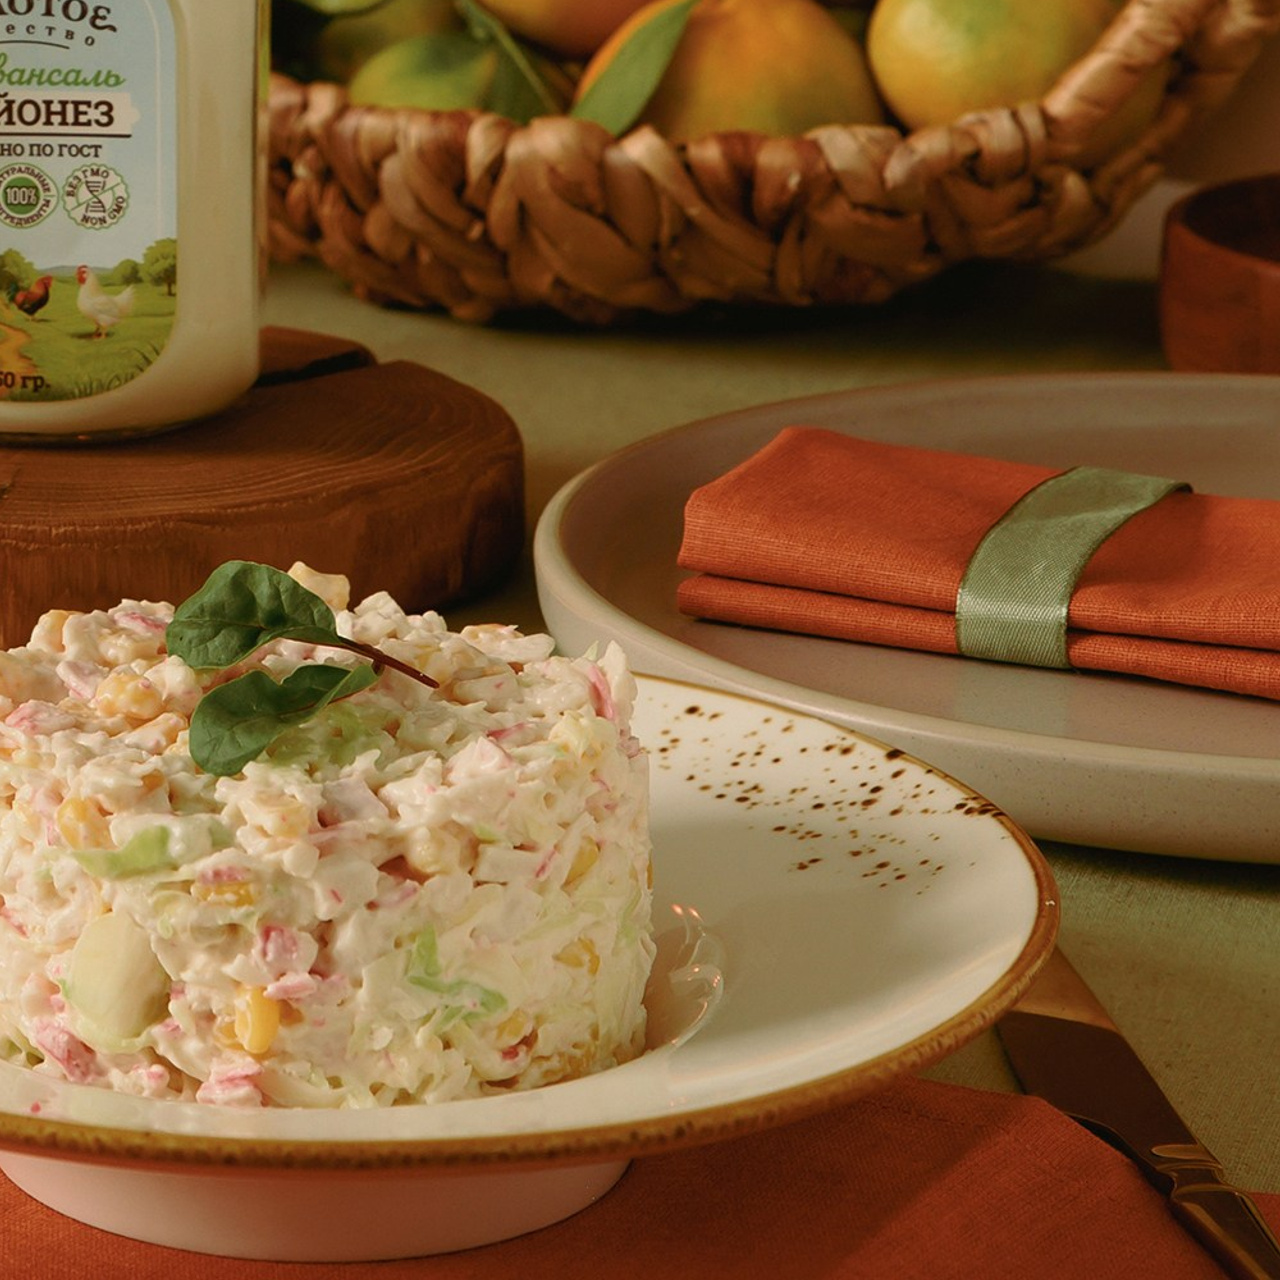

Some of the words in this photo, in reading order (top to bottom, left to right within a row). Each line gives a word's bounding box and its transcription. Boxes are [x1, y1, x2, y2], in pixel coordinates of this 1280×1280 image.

[28, 143, 54, 157] ПО
[60, 143, 102, 158] ГОСТ
[66, 175, 82, 197] БЕЗ
[81, 167, 109, 179] ГМО
[5, 187, 38, 205] 100%
[81, 214, 107, 226] NON
[108, 196, 125, 220] GMO
[20, 376, 51, 392] гр.
